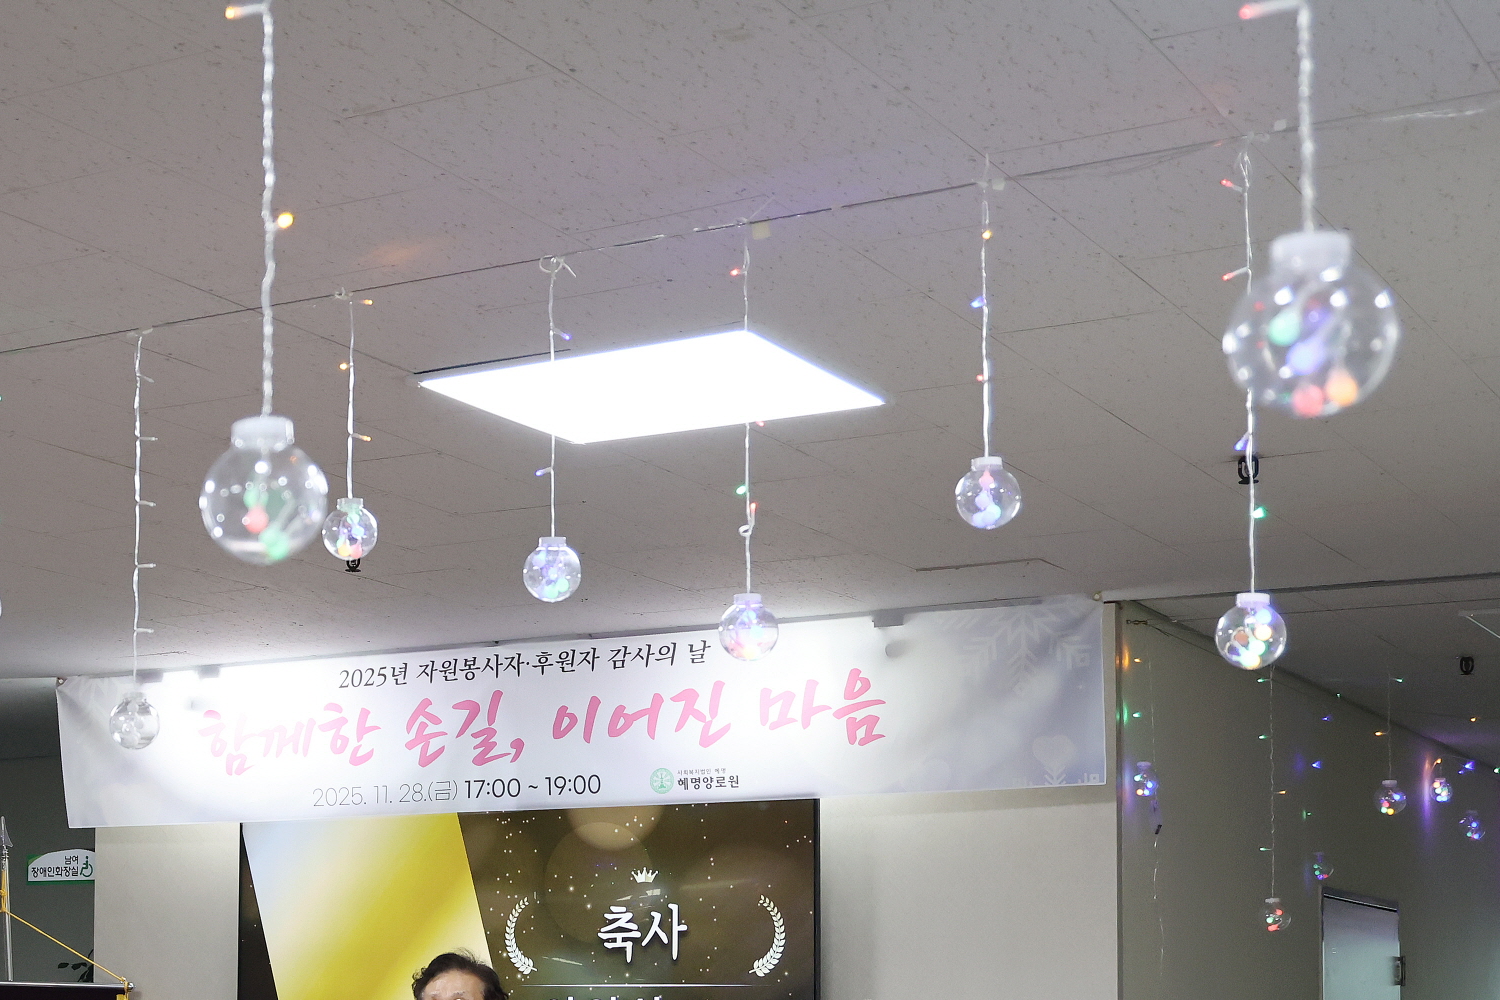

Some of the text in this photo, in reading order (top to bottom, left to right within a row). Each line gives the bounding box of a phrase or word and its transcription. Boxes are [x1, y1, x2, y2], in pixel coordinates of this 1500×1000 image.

[338, 639, 712, 690] 2025년 자원봉사자·후원자 감사의 날
[198, 667, 887, 776] 함께한 손길, 이어진 마음
[312, 786, 367, 807] 2025.
[373, 784, 393, 804] 11.
[464, 778, 521, 800] 17:00
[544, 774, 602, 797] 19:00
[677, 774, 739, 791] 혜명양로원
[31, 866, 79, 878] 장애인화장실
[65, 855, 79, 865] 남여
[597, 903, 688, 964] 축사
